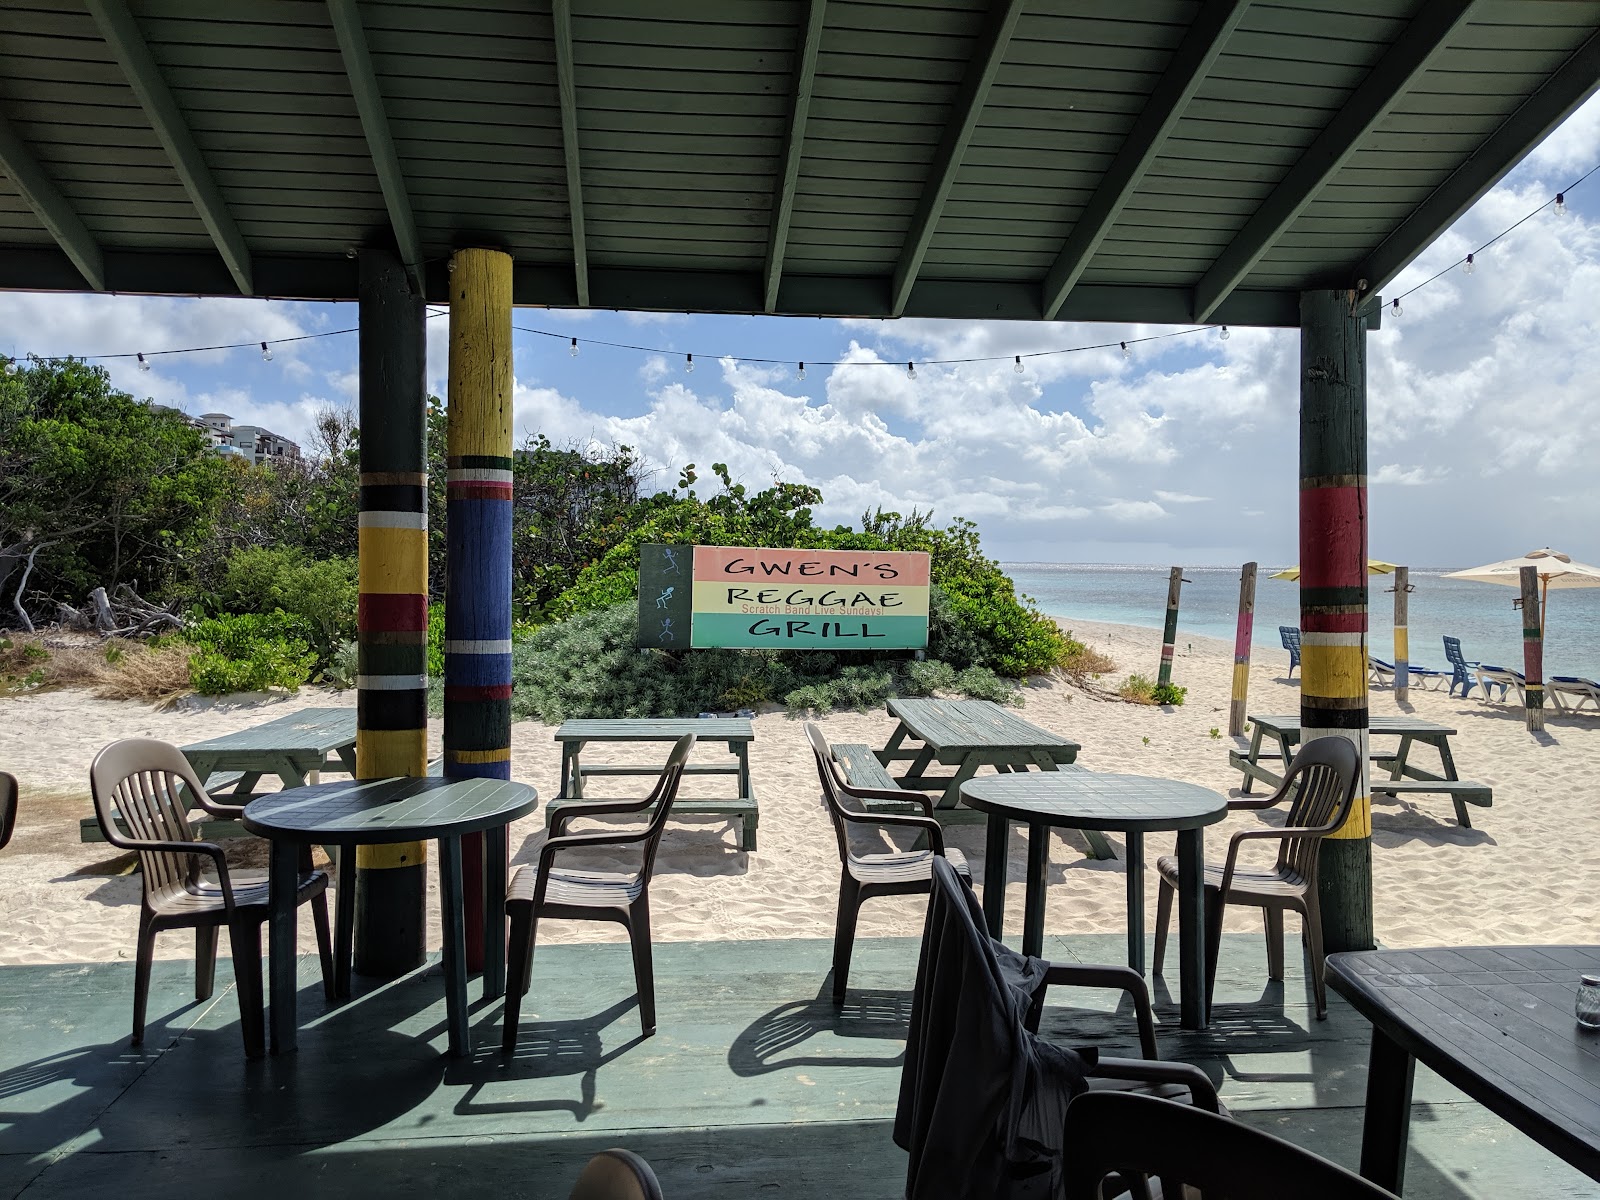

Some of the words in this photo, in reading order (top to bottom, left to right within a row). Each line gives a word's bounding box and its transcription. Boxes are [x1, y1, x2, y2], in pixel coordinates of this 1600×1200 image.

[724, 558, 899, 579] GWEN'S
[727, 588, 903, 608] REGGAE
[741, 604, 780, 614] Scratch
[785, 605, 811, 615] Band
[814, 605, 835, 615] Live
[839, 605, 884, 616] Sundays!
[748, 618, 886, 638] GRILL
